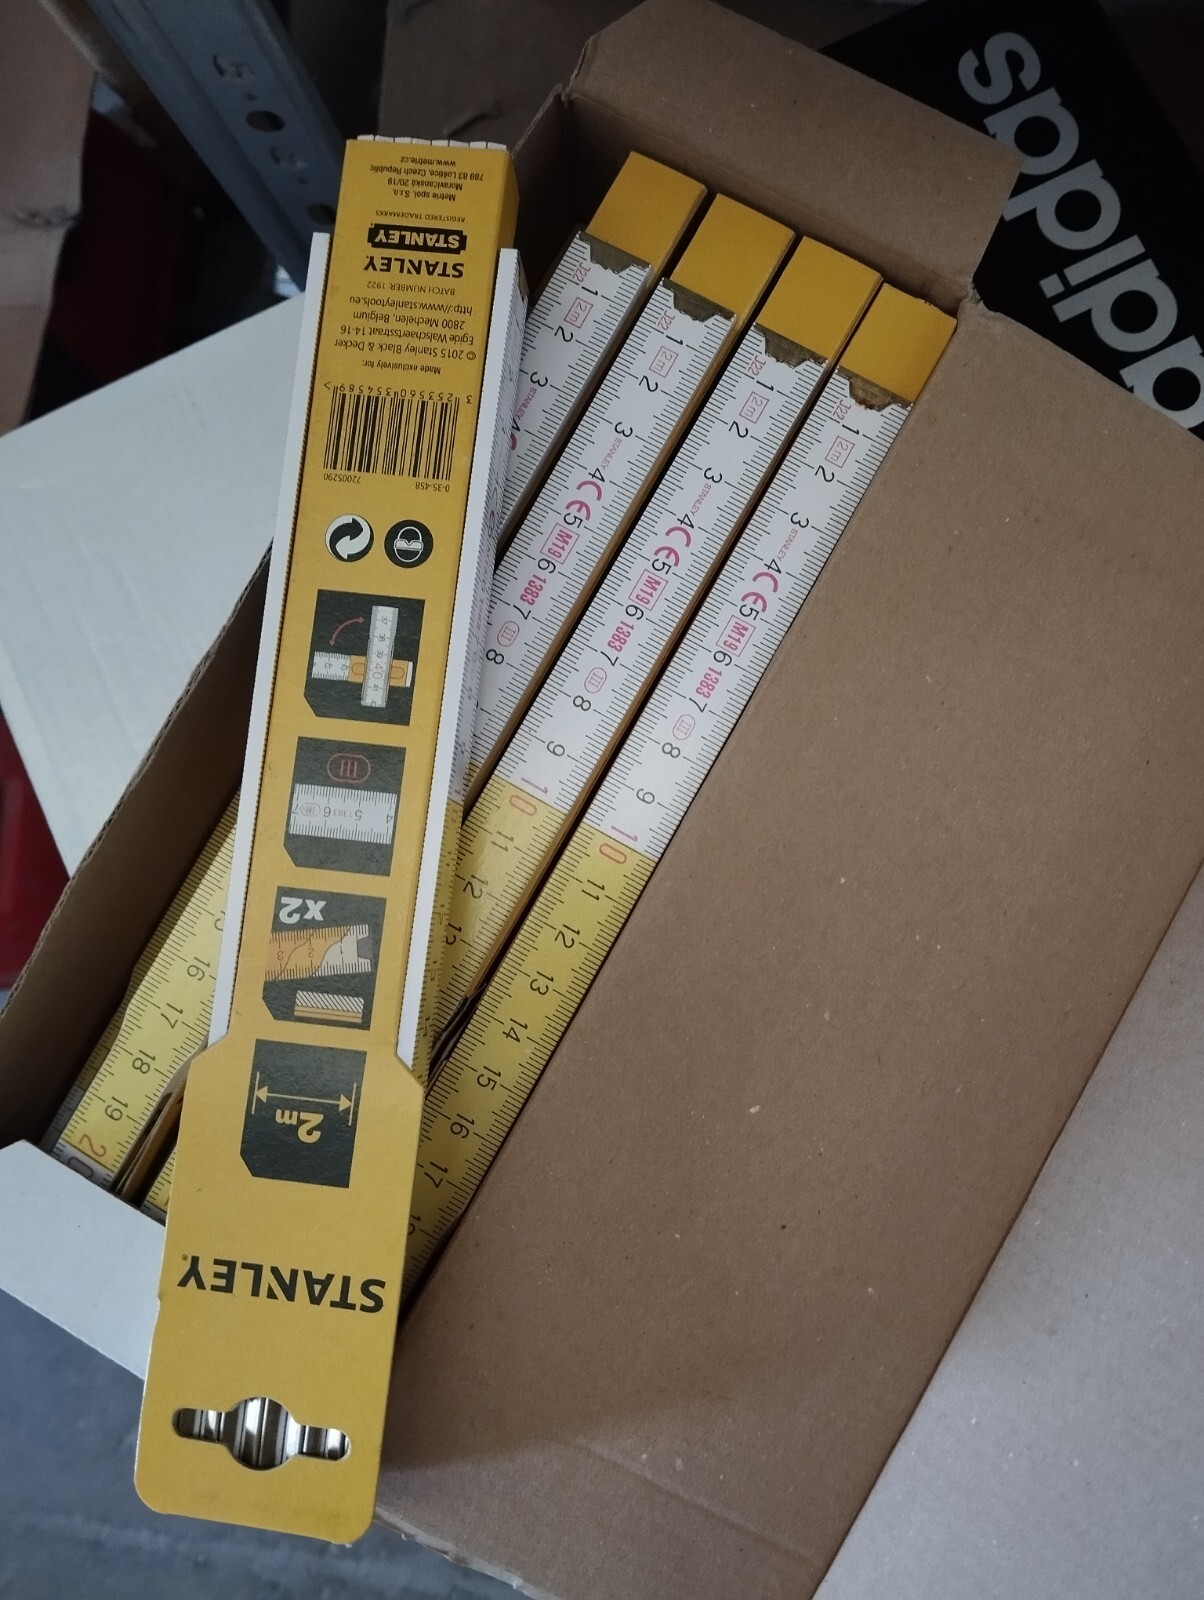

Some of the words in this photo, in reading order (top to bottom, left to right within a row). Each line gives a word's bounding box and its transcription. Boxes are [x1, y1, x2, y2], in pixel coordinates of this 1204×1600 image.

[370, 165, 401, 175] Republic
[401, 157, 456, 167] www.metrie.cz
[404, 168, 426, 176] Czech
[470, 172, 483, 180] 789
[388, 178, 409, 186] 20/19
[414, 190, 430, 199] spol.
[433, 193, 456, 201] Metrie
[376, 210, 422, 219] TRADEMARKS
[425, 214, 465, 222] REGISTERED
[375, 230, 460, 248] STANLEY
[363, 256, 464, 278] STANLEY
[367, 281, 385, 289] 1922
[429, 286, 455, 295] BATCH
[581, 286, 599, 296] 1
[349, 296, 472, 316] http://www.stanleytools.eu
[353, 310, 389, 323] Belgium
[393, 314, 439, 327] Mechelen,
[442, 319, 465, 329] 2800
[341, 325, 365, 336] 14-16
[369, 327, 447, 343] Walschaertsstraat
[554, 326, 574, 343] 2
[334, 339, 364, 351] Decker
[369, 342, 374, 351] &
[450, 333, 473, 345] Egide
[666, 335, 683, 346] 1
[378, 343, 401, 354] Black
[405, 344, 437, 357] Stanley
[441, 349, 463, 359] 2015
[362, 360, 374, 368] for:
[377, 360, 418, 370] exclusively
[420, 365, 441, 374] Made
[530, 372, 548, 387] 3
[639, 376, 658, 392] 2
[756, 380, 774, 390] 1
[516, 387, 537, 420] STANLEY
[614, 422, 633, 438] 3
[728, 421, 748, 438] 2
[842, 424, 860, 435] 1
[602, 437, 622, 470] STANLEY
[324, 473, 361, 483] 72005290
[588, 468, 606, 482] 4
[703, 468, 722, 483] 3
[815, 465, 835, 482] 2
[415, 482, 450, 492] 0-35-458
[690, 483, 712, 516] STANLEY
[563, 512, 583, 528] 5
[677, 513, 695, 529] 4
[790, 512, 809, 528] 3
[548, 529, 572, 560] M19
[777, 528, 798, 562] STANLEY
[537, 558, 556, 574] 6
[652, 558, 671, 574] 5
[764, 558, 782, 574] 4
[520, 574, 546, 606] 1383
[635, 576, 661, 605] M19
[513, 605, 531, 620] 7
[625, 604, 644, 620] 6
[739, 604, 760, 620] 5
[381, 616, 388, 625] 37
[607, 620, 635, 652] 1383
[723, 622, 749, 650] M19
[376, 649, 384, 658] 39
[486, 649, 504, 664] 8
[600, 651, 619, 667] 7
[713, 650, 732, 666] 6
[372, 663, 382, 679] 40
[696, 667, 722, 698] 1383
[572, 695, 591, 711] 8
[689, 697, 707, 713] 7
[546, 741, 565, 757] 9
[662, 742, 680, 758] 8
[636, 788, 655, 804] 9
[292, 804, 299, 814] 7
[324, 806, 331, 817] 6
[333, 809, 352, 817] 1383
[355, 810, 362, 820] 5
[386, 813, 393, 823] 4
[491, 831, 514, 851] 11
[463, 874, 488, 899] 12
[582, 879, 605, 901] 11
[279, 897, 327, 924] x2
[555, 924, 581, 948] 12
[187, 956, 210, 981] 16
[529, 970, 554, 996] 13
[160, 1002, 183, 1029] 17
[502, 1017, 528, 1043] 14
[132, 1050, 156, 1074] 18
[476, 1065, 502, 1091] 15
[105, 1096, 128, 1121] 19
[450, 1113, 475, 1139] 16
[424, 1161, 448, 1188] 17
[176, 1255, 386, 1313] STANLEY
